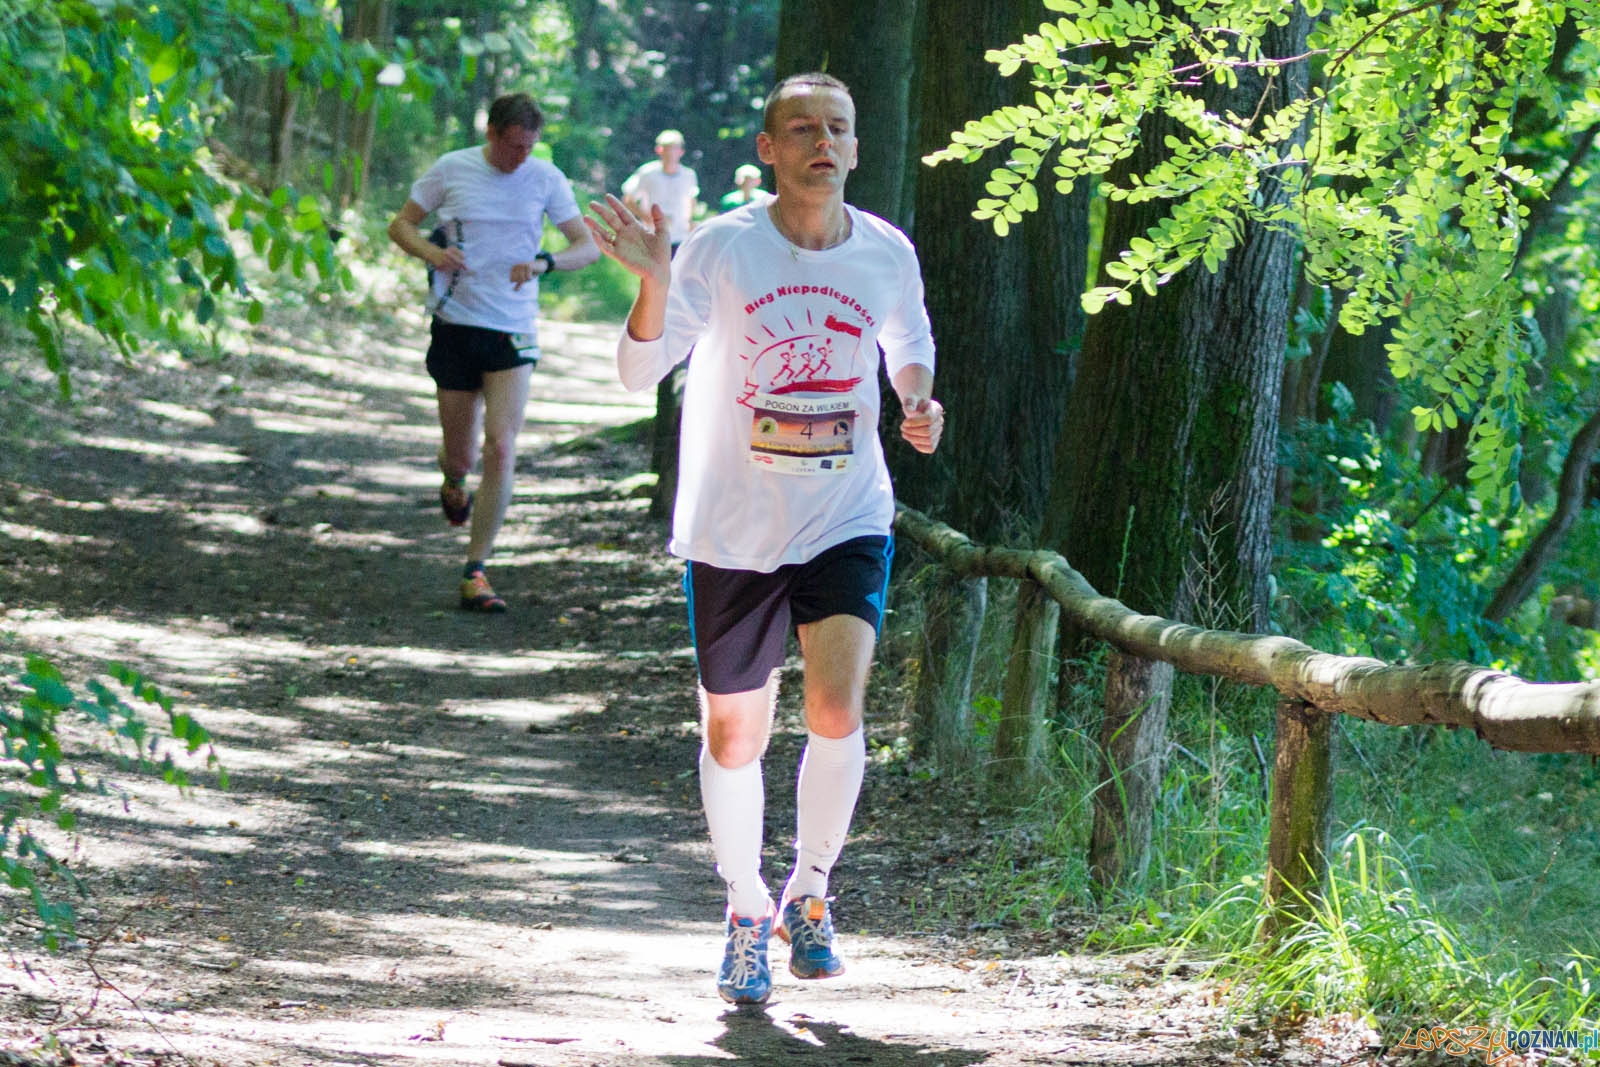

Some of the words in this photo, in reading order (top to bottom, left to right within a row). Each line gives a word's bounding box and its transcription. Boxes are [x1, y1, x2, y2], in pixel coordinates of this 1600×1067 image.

[744, 293, 775, 315] Bieg
[802, 404, 814, 412] ZA
[800, 421, 813, 440] 4
